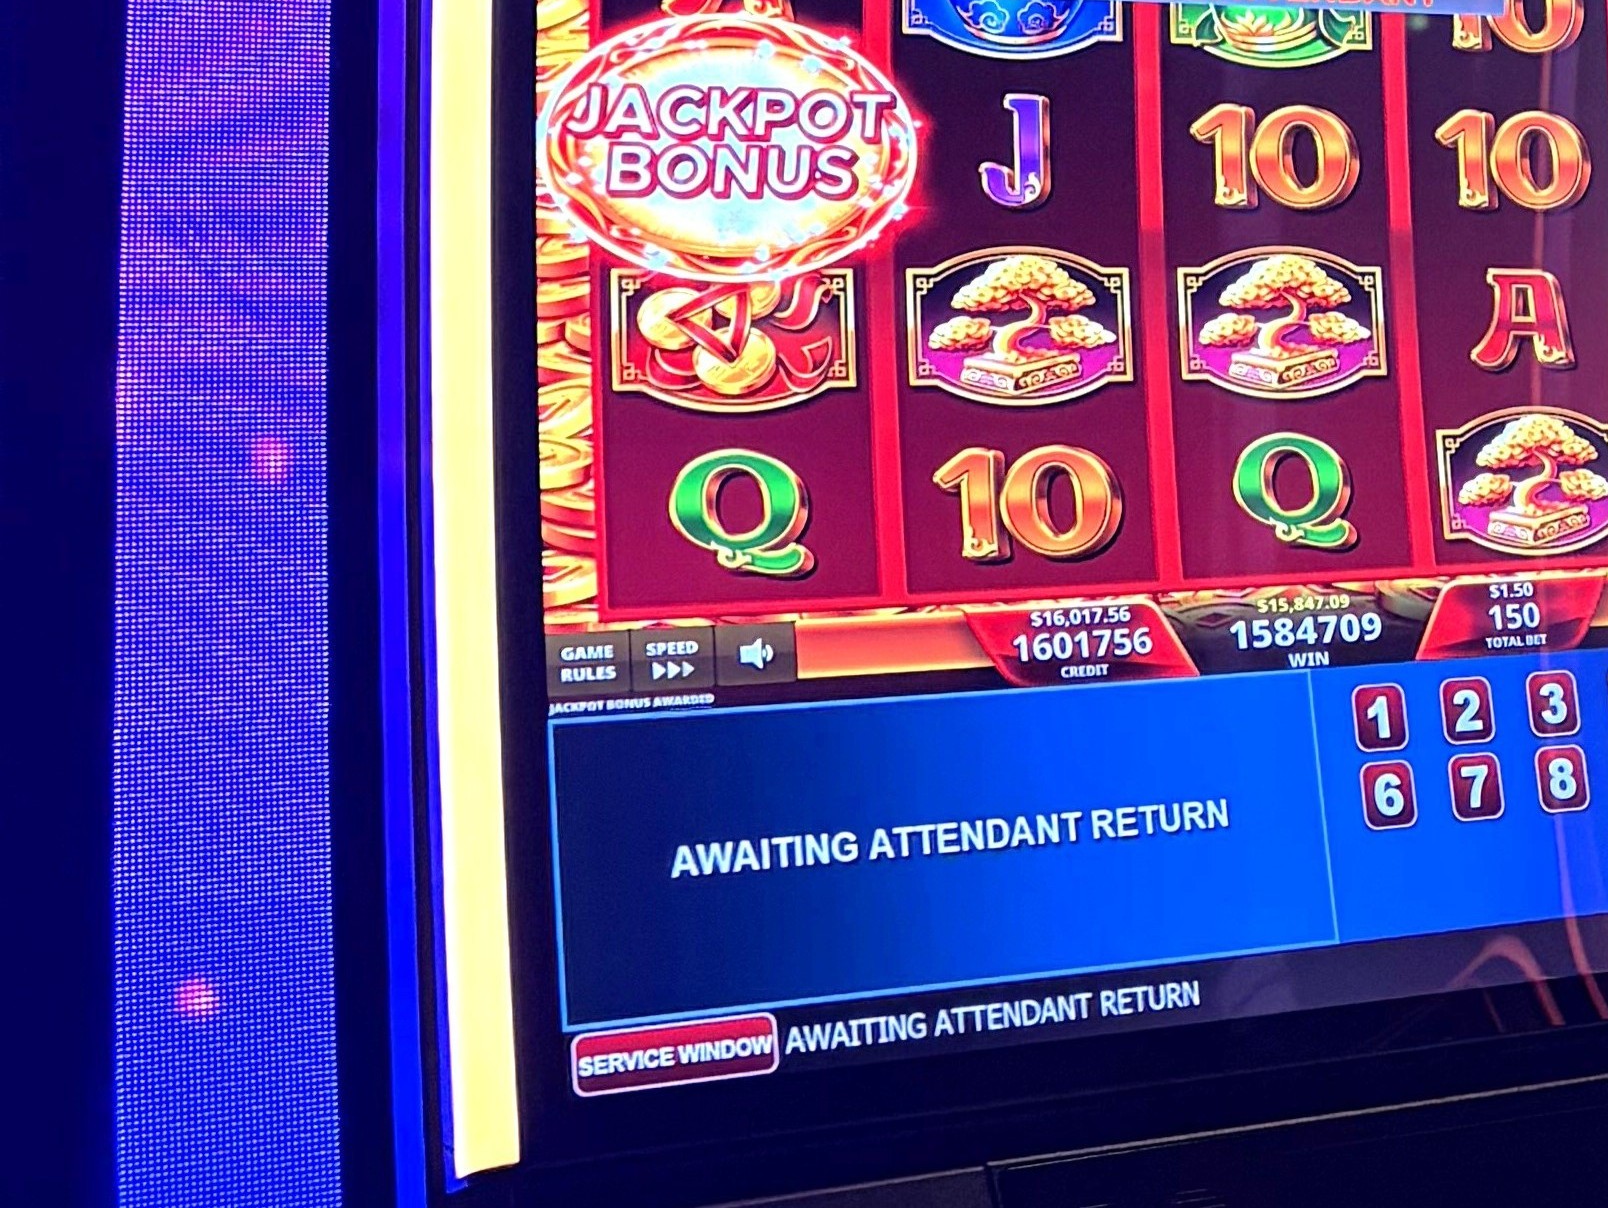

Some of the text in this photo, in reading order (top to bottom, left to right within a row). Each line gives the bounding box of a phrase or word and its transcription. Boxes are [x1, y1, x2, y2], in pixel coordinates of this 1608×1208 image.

[566, 84, 896, 144] JACKPOT
[978, 92, 1051, 208] J
[1189, 102, 1360, 211] 10
[1434, 108, 1591, 211] 10
[603, 143, 861, 202] BONUS
[1469, 267, 1576, 373] A
[668, 447, 816, 577] Q
[932, 443, 1122, 562] 10
[1232, 431, 1359, 550] Q
[1257, 593, 1350, 615] $15,847.09
[1490, 582, 1534, 600] $1.50
[1030, 605, 1131, 628] $16,017.56
[1229, 612, 1382, 650] 1584709
[1488, 602, 1541, 631] 150
[561, 645, 614, 661] GAME
[646, 640, 698, 657] SPEED
[1012, 627, 1153, 663] 1601756
[1288, 650, 1330, 668] WIN
[1485, 633, 1548, 650] TOTAL BET
[561, 666, 616, 683] RULES
[1060, 663, 1109, 679] CREDIT
[549, 693, 715, 716] JACKPOT BONUS AWARDED
[1367, 695, 1392, 739] 1
[1455, 689, 1483, 732] 2
[1540, 683, 1567, 725] 3
[1374, 773, 1401, 817] 6
[1461, 765, 1487, 808] 7
[1549, 757, 1575, 799] 8
[671, 798, 1230, 879] AWAITING ATTENDANT RETURN
[785, 980, 1200, 1055] AWAITING ATTENDANT RETURN
[578, 1034, 773, 1077] SERVICE WINDOW
